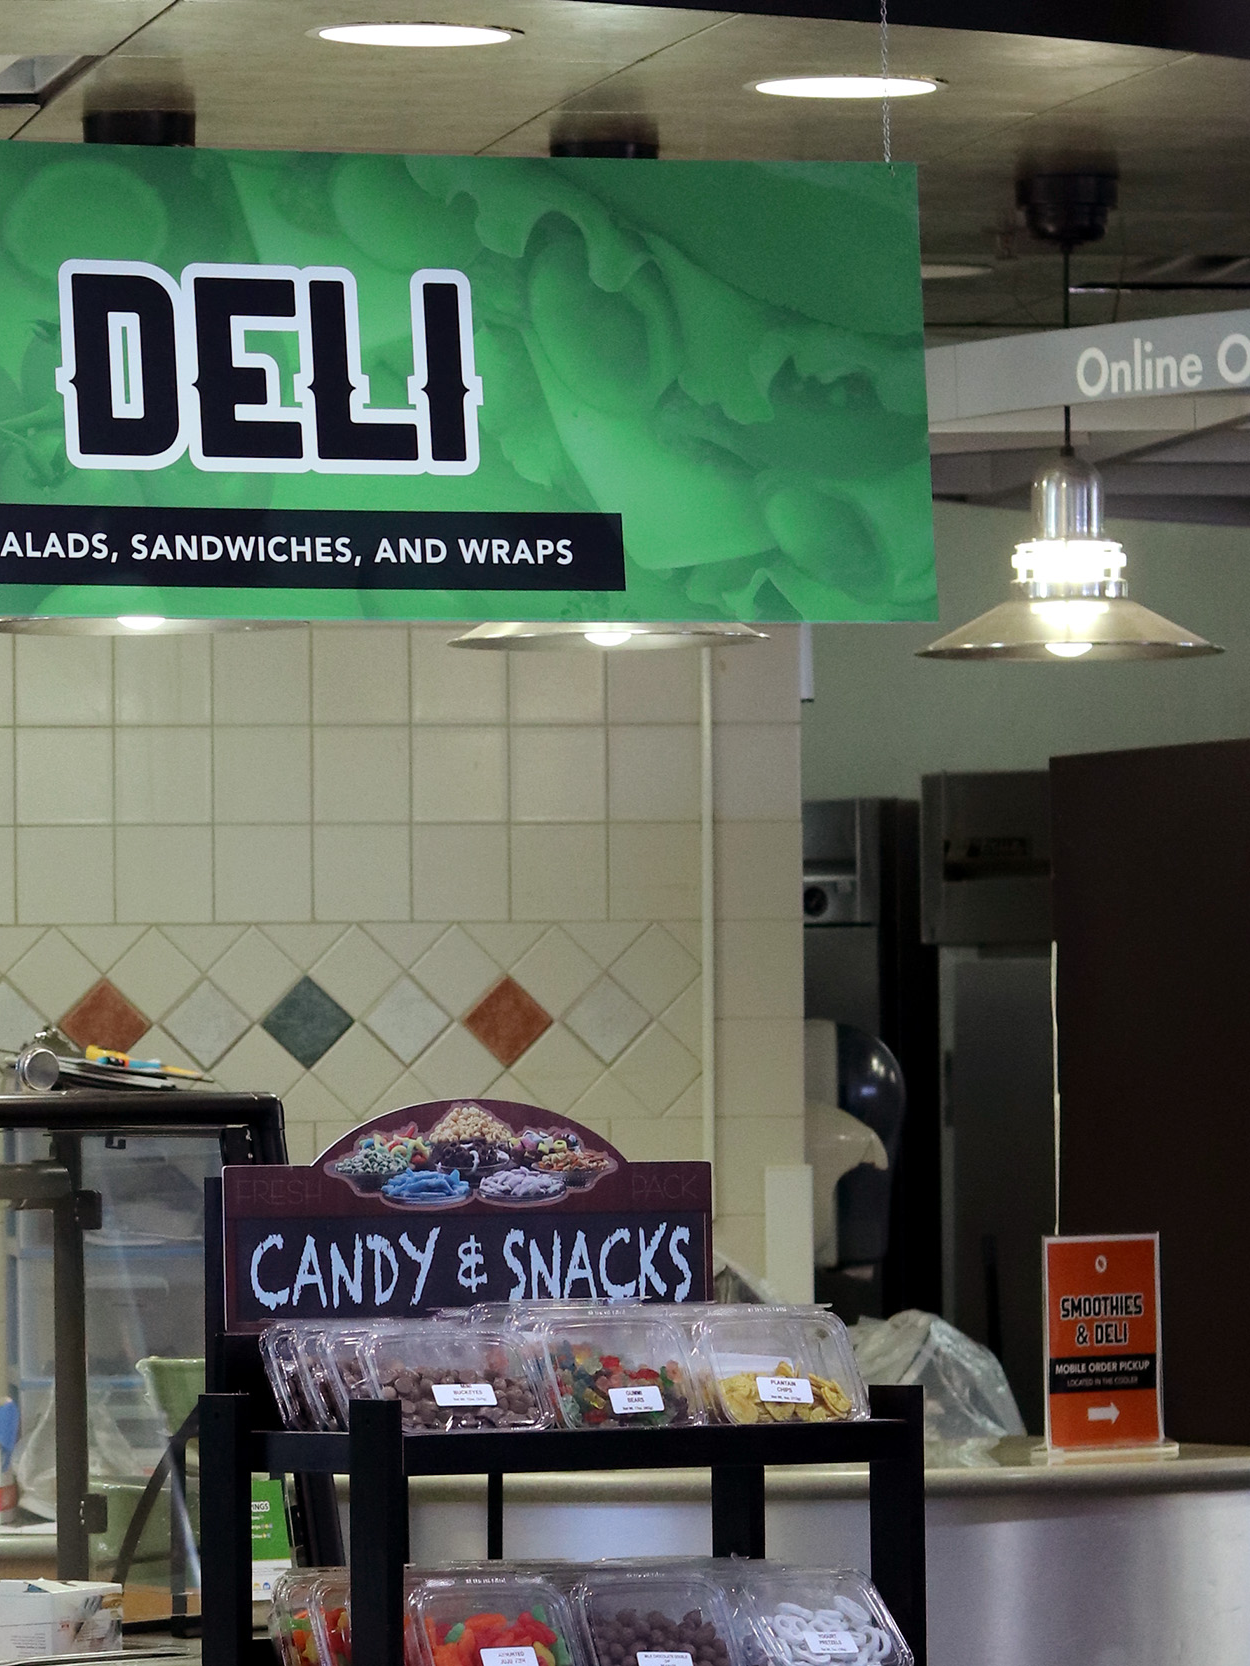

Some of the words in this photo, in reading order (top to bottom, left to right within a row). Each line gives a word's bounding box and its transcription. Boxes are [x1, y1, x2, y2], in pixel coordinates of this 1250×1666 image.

[57, 260, 481, 475] DELI
[1076, 338, 1203, 397] Online
[130, 533, 362, 568] SANDWICHES,
[375, 538, 448, 564] AND
[458, 538, 574, 567] WRAPS
[236, 1178, 324, 1205] FRESH
[632, 1173, 698, 1200] PACK
[250, 1226, 441, 1310] CANDY
[456, 1234, 488, 1293] &
[502, 1222, 693, 1303] SNACKS
[1060, 1294, 1144, 1320] SMOOTHIES
[1076, 1323, 1090, 1346] &
[1094, 1322, 1129, 1345] DELI
[1055, 1362, 1087, 1375] MOBILE
[1088, 1361, 1118, 1373] ORDER
[1119, 1360, 1150, 1371] PICKUP
[1067, 1378, 1093, 1387] LOCATED
[1102, 1377, 1113, 1385] THE
[1114, 1376, 1138, 1384] COOLER
